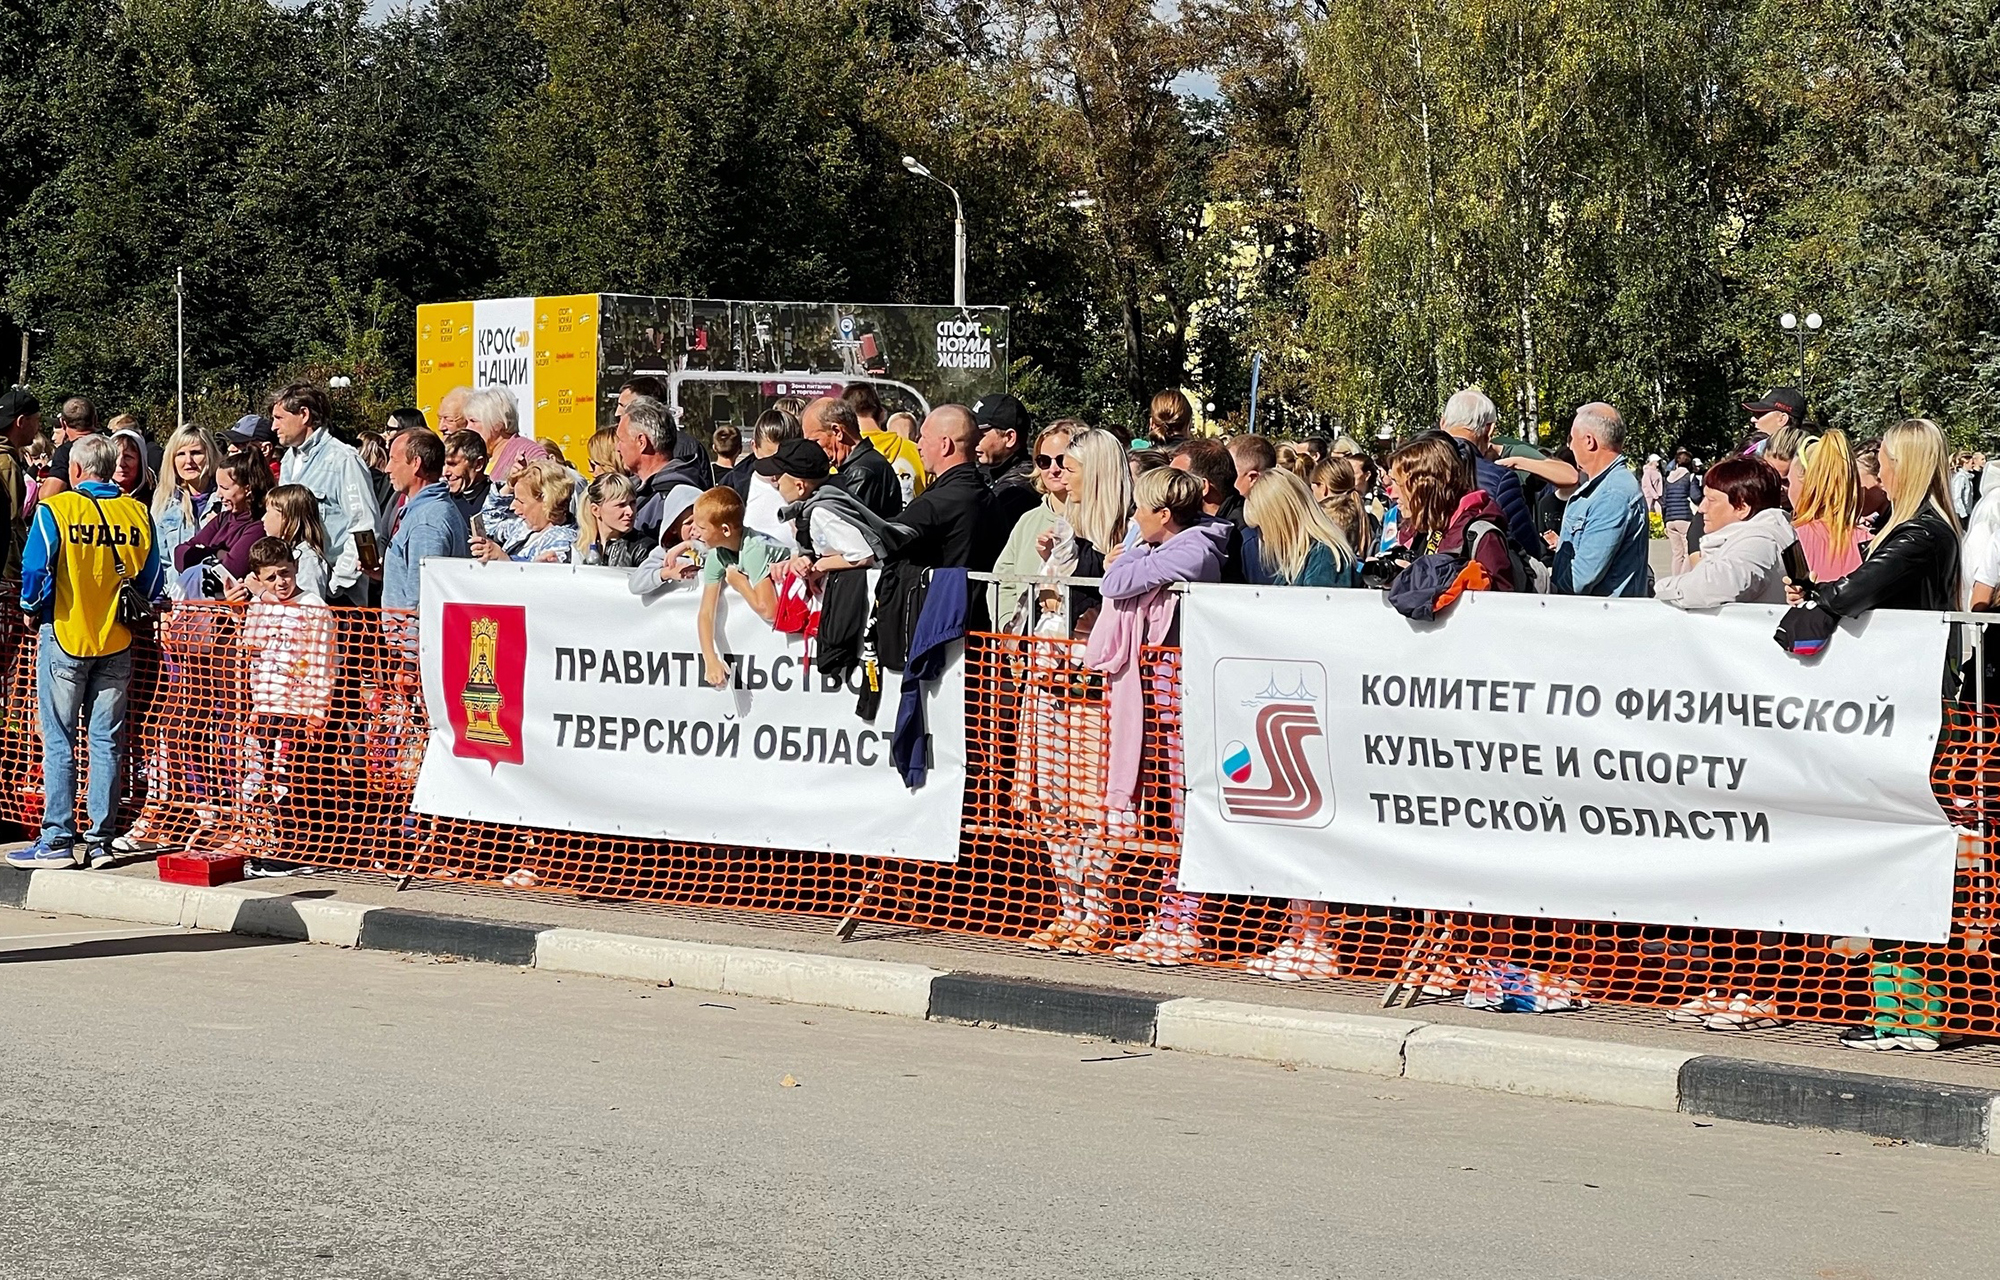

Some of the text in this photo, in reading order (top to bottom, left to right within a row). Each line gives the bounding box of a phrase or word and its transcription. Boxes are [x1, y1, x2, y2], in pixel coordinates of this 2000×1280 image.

[479, 327, 516, 355] КРОСС
[937, 320, 981, 336] СПОРТ
[937, 337, 990, 352] НОРМА
[479, 358, 527, 387] НАЦИИ
[937, 352, 990, 368] ЖИЗНИ
[69, 525, 140, 547] СУДЬЯ
[1362, 674, 1895, 737] КОМИТЕТ ПО ФИЗИЧЕСКОЙ
[553, 713, 740, 758] ТВЕРСКОЙ
[1364, 734, 1747, 790] КУЛЬТУРЕ И СПОРТУ
[1369, 793, 1770, 843] ТВЕРСКОЙ ОБЛАСТИ
